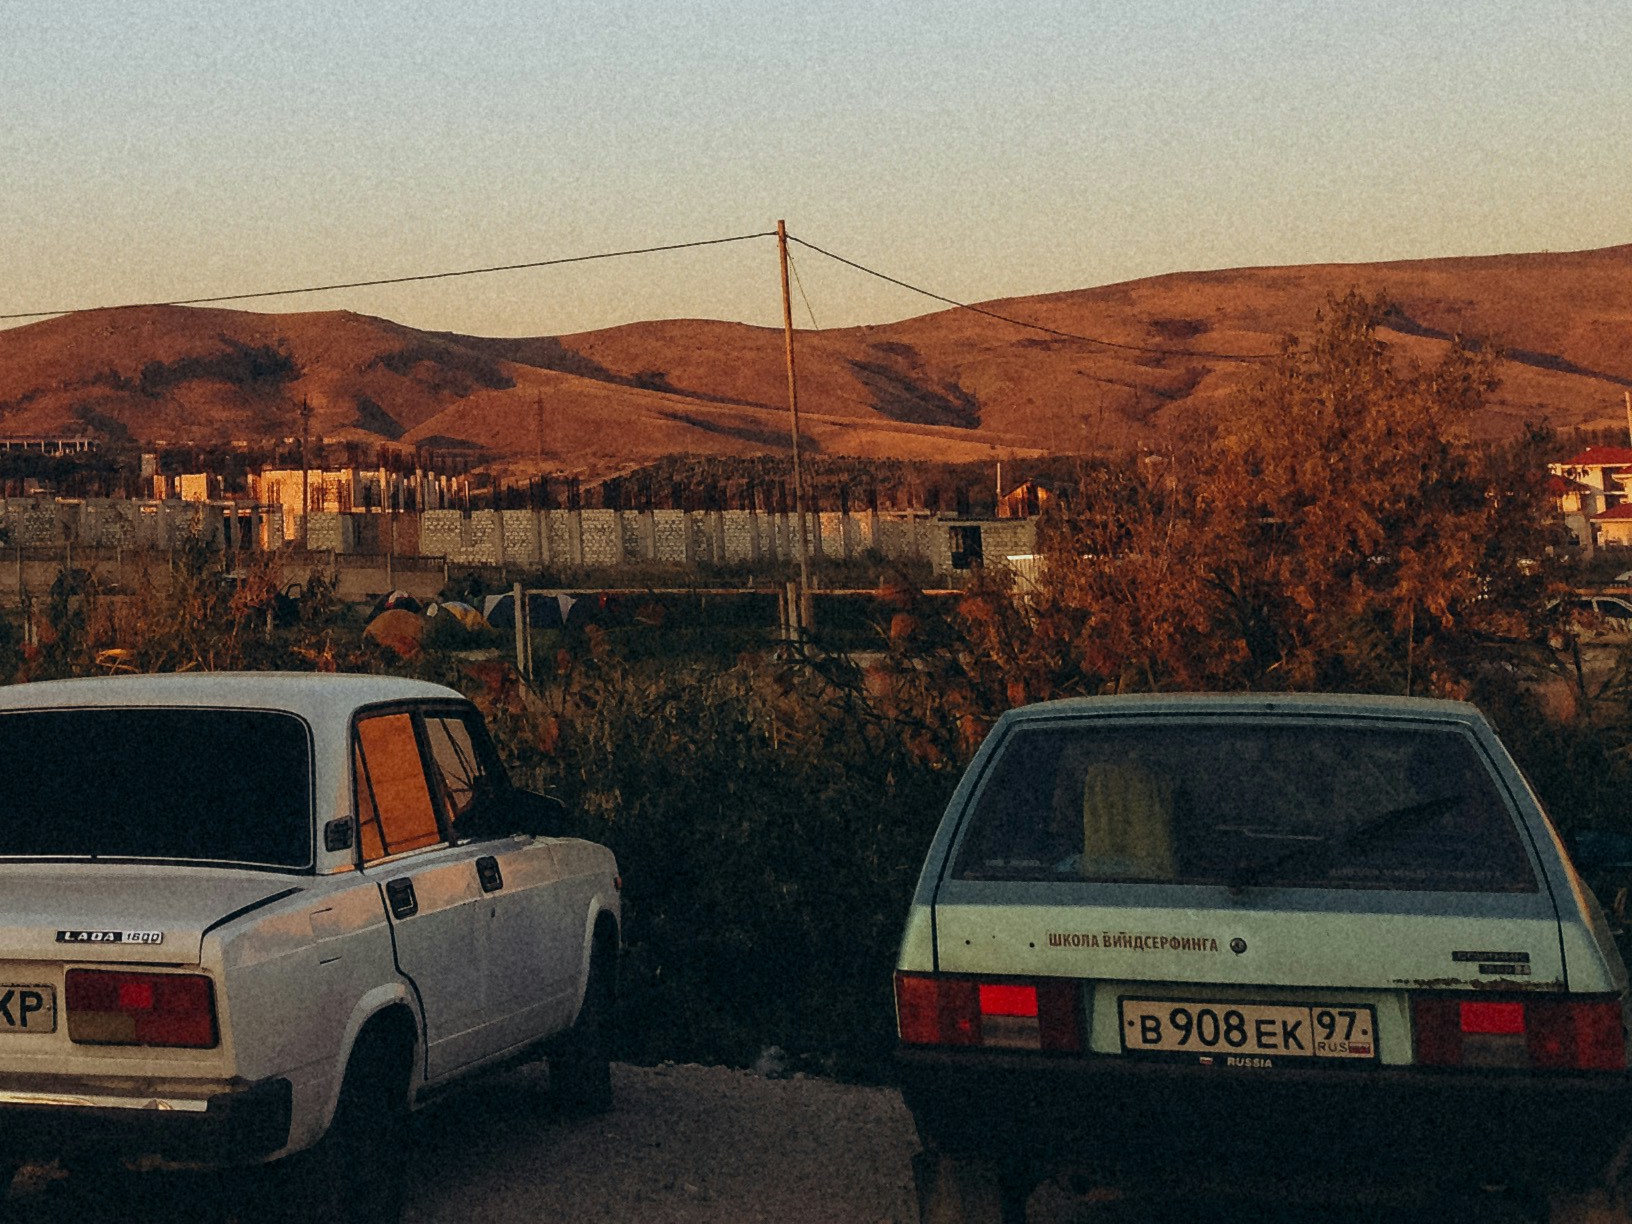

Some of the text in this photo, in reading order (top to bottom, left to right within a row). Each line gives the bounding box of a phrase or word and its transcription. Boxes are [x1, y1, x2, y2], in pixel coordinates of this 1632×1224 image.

[1048, 933, 1099, 948] ШКОЛА
[1317, 1011, 1356, 1040] 97
[1318, 1041, 1349, 1053] RUS
[1227, 1057, 1273, 1068] RUSSIA
